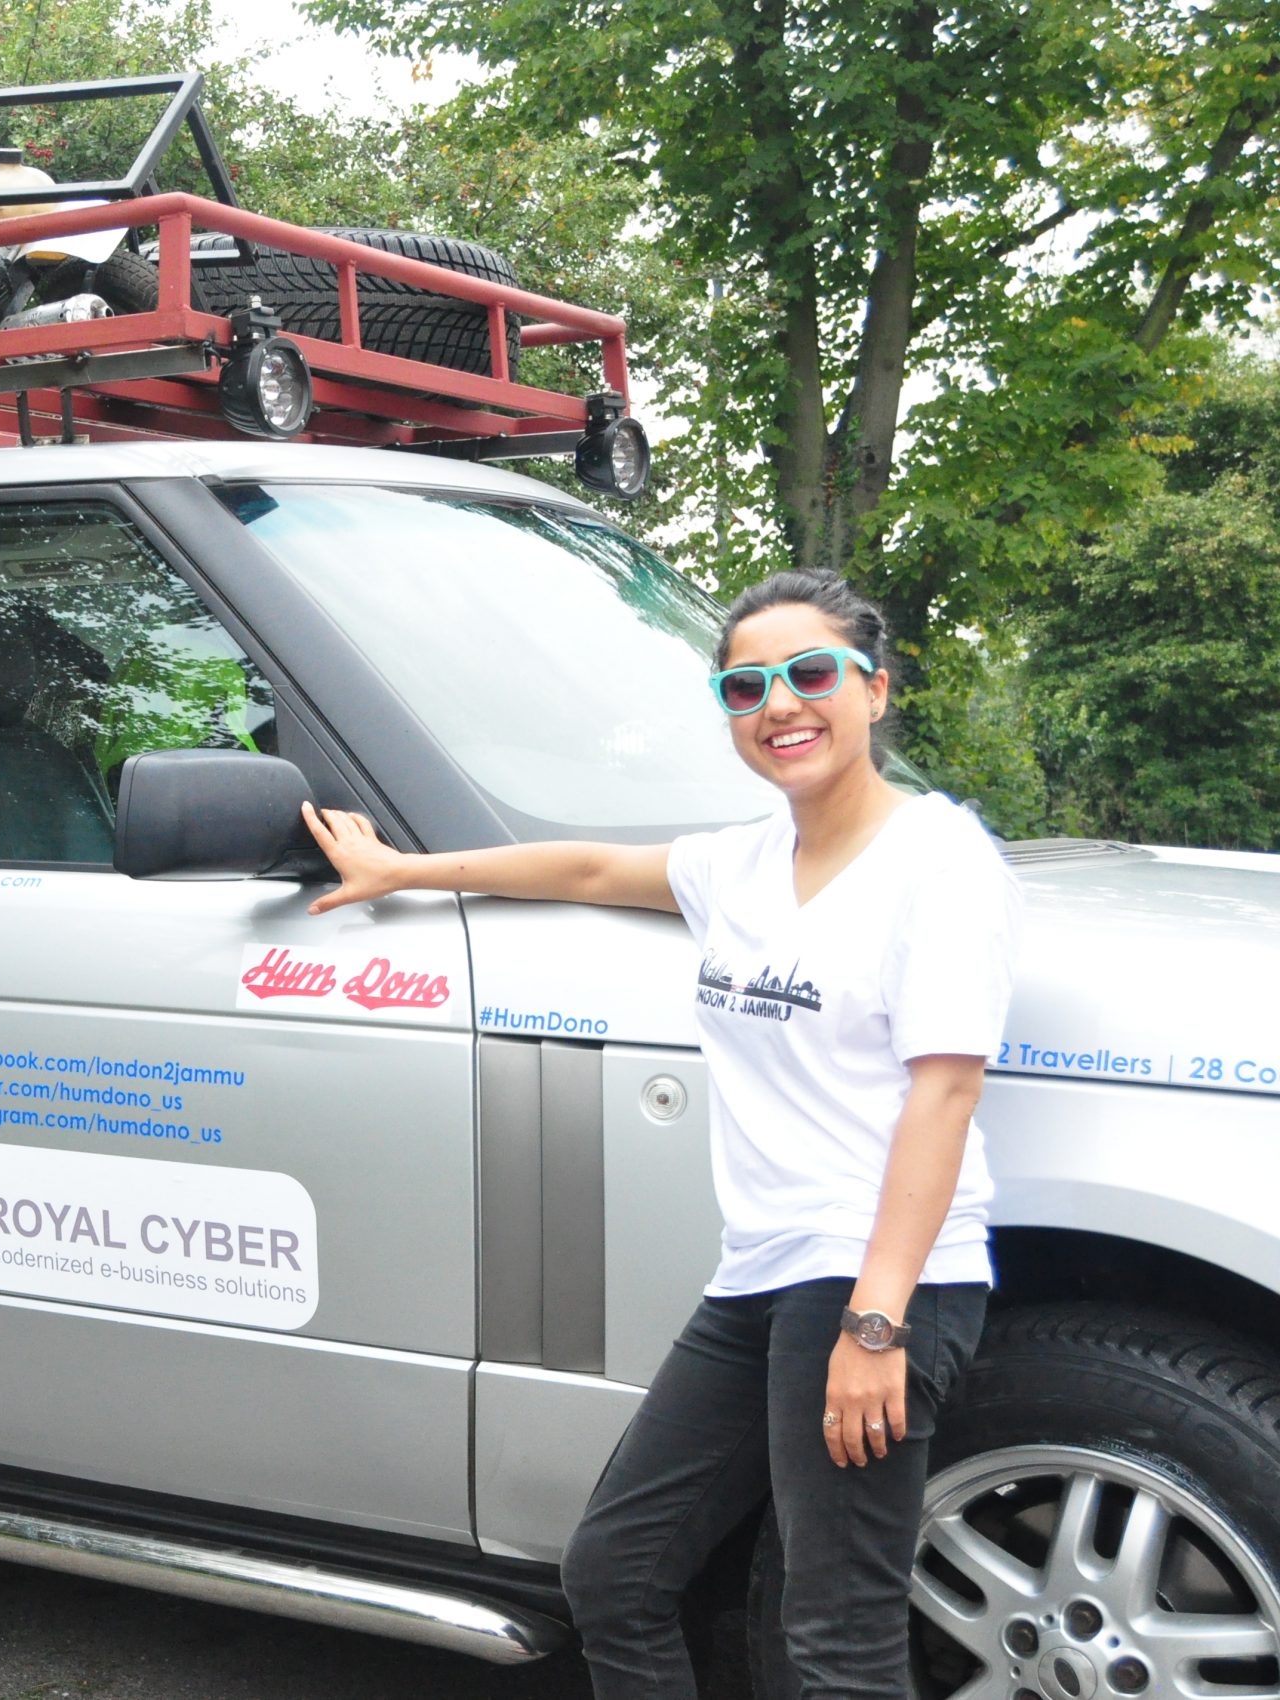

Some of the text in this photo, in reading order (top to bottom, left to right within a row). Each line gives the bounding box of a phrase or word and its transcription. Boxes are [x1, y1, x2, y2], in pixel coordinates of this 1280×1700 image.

[241, 948, 450, 1010] Hum Dono
[479, 1006, 609, 1036] #HumDono
[739, 999, 792, 1021] JAMMU
[1019, 1043, 1152, 1075] Travellers
[1189, 1056, 1223, 1081] 28
[140, 1214, 303, 1272] CYBER
[101, 1261, 209, 1293] e-business
[214, 1277, 308, 1305] solutions
